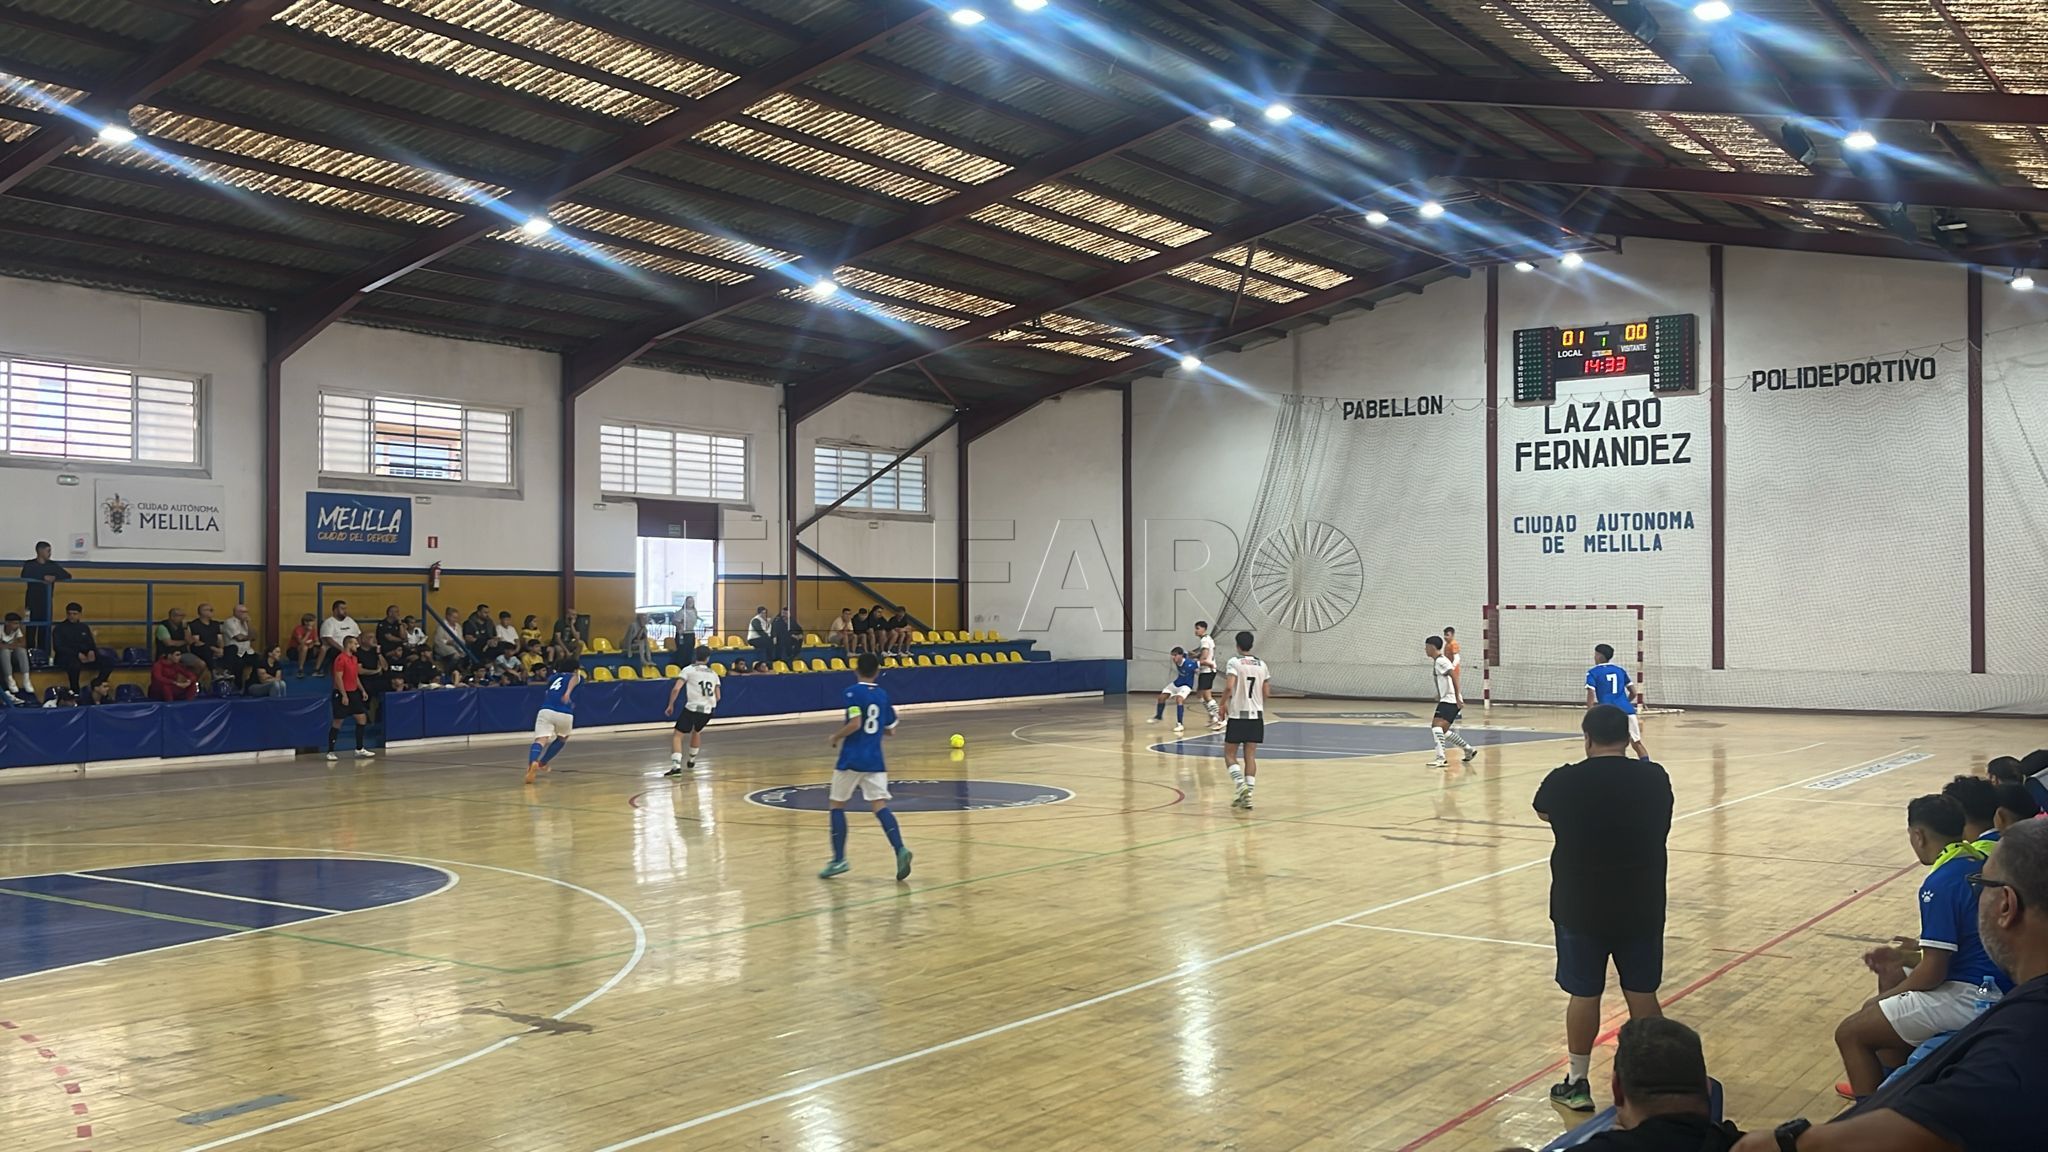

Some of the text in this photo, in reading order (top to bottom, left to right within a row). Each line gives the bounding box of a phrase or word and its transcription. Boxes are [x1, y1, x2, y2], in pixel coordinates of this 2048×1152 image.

[1562, 330, 1585, 346] 01
[1602, 336, 1607, 347] 1
[1625, 323, 1648, 341] 00
[1557, 349, 1583, 358] LOCAL
[1620, 343, 1647, 352] VISITANTE
[1584, 356, 1627, 373] 14:33
[1752, 357, 1936, 392] POLIDEPORTIVO
[1343, 395, 1443, 420] PABELLON
[1544, 398, 1662, 434] LAZARO
[1515, 432, 1692, 472] FERNANDEZ
[137, 503, 169, 511] CIUDAD
[140, 513, 220, 532] MELILLA
[317, 506, 402, 533] MELILLA
[1514, 511, 1695, 533] CIUDAD AUTONOMA
[317, 531, 399, 544] CIUDAD DEL DEPORTE
[1543, 533, 1663, 554] DE MELILLA
[550, 677, 562, 691] 4
[1246, 676, 1257, 699] 7
[1606, 673, 1619, 694] 7
[864, 703, 880, 735] 8
